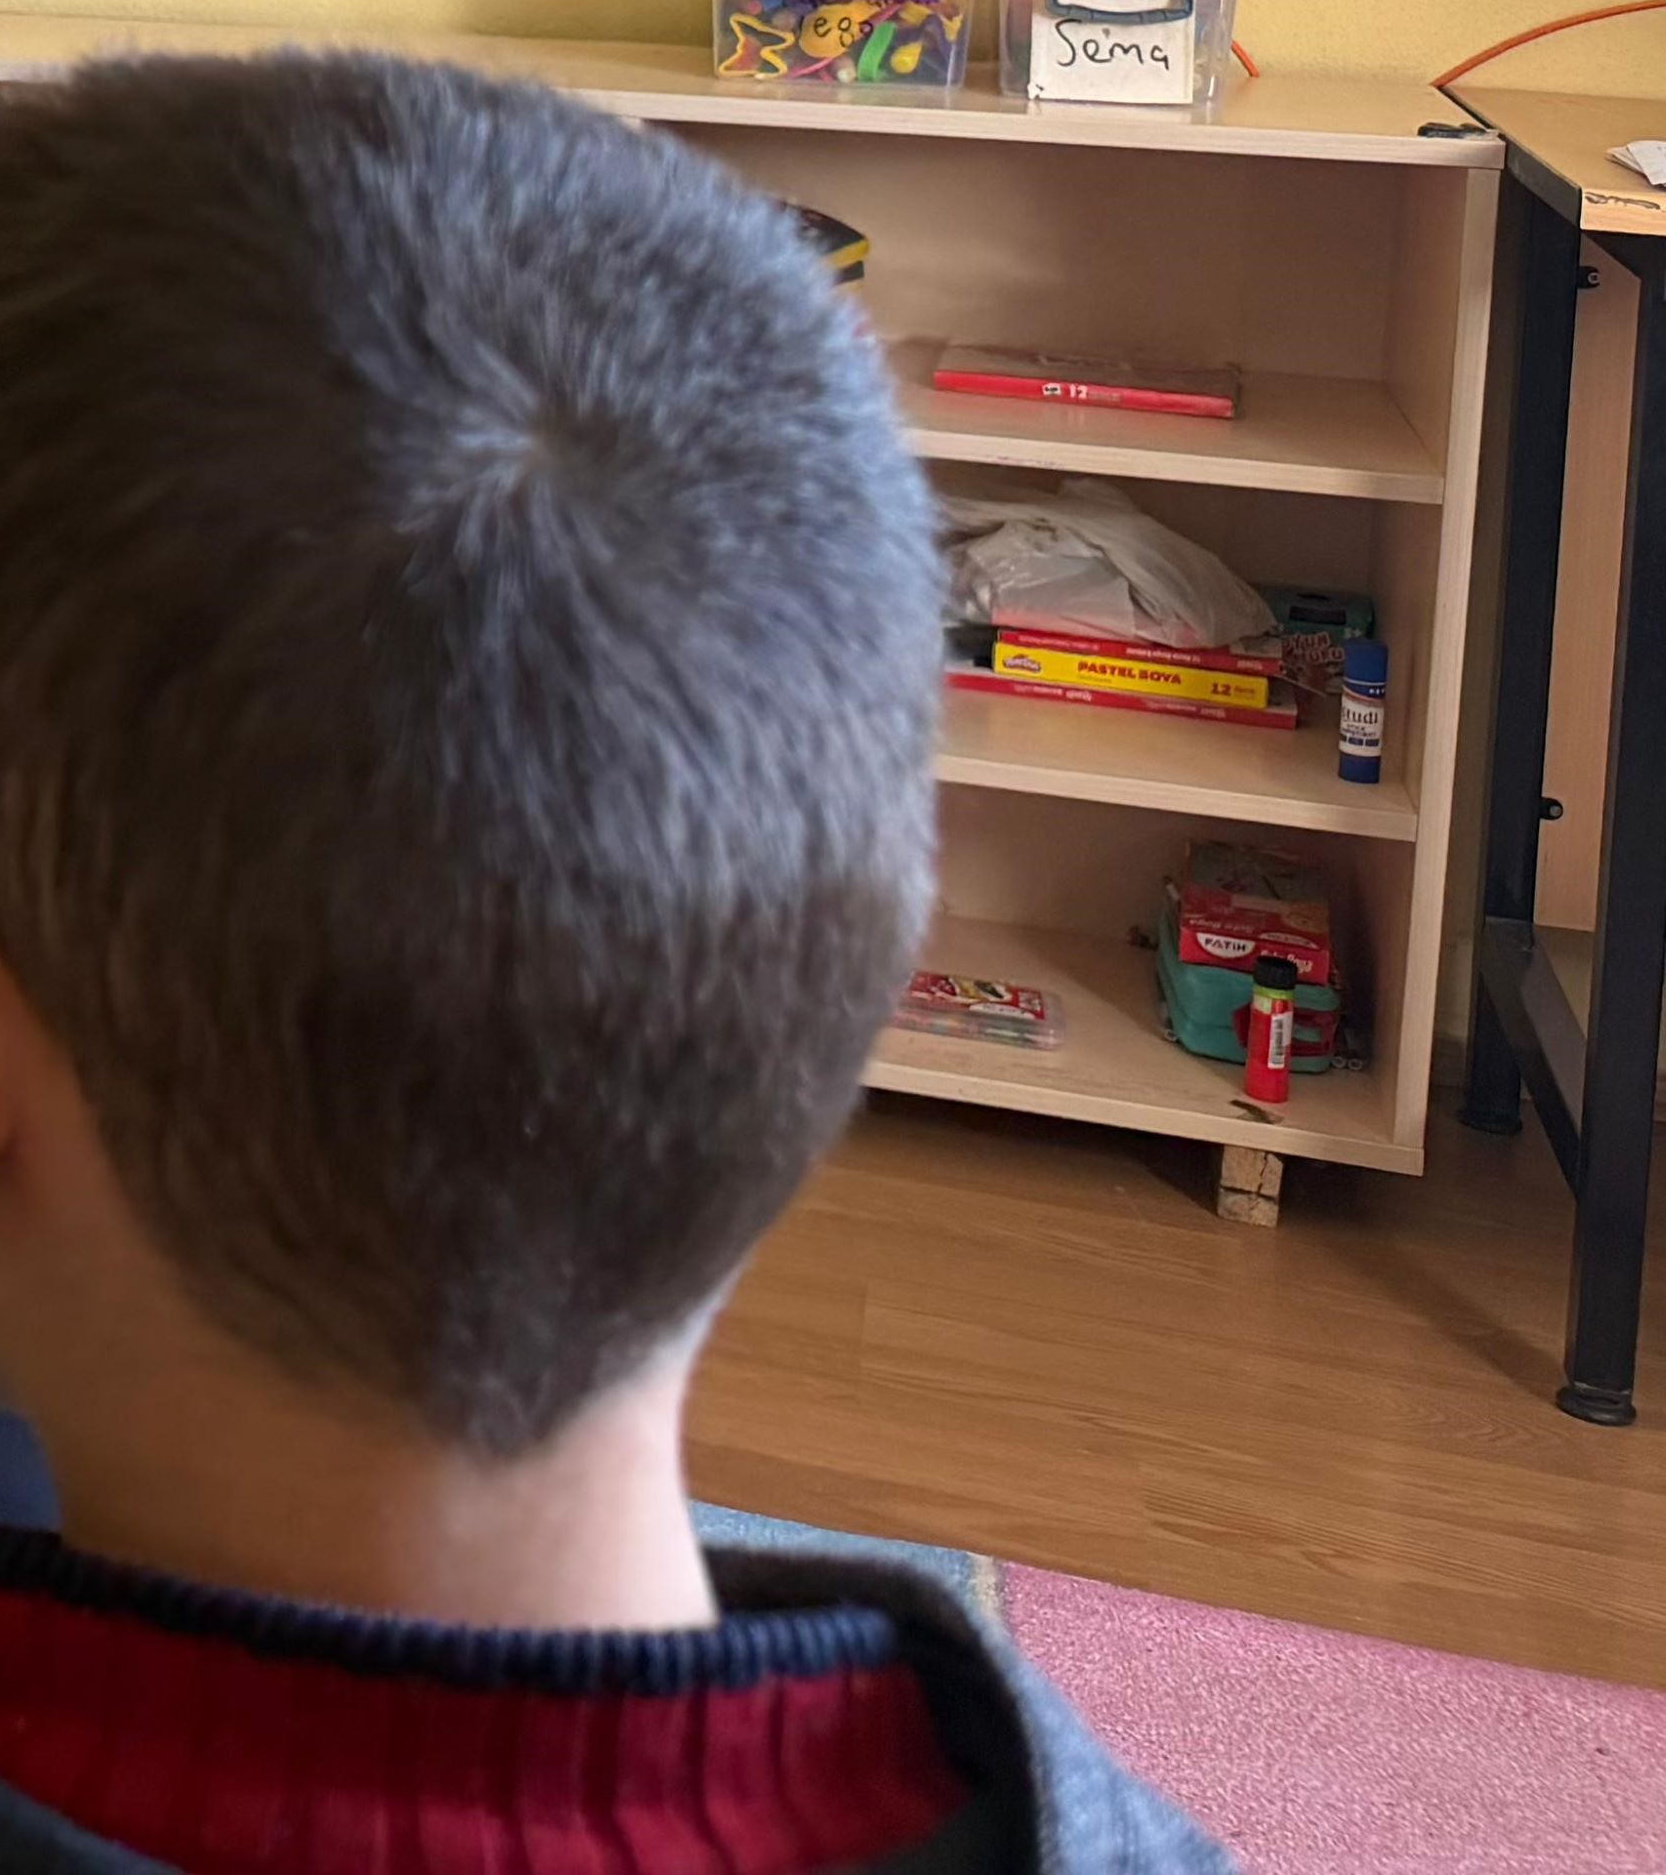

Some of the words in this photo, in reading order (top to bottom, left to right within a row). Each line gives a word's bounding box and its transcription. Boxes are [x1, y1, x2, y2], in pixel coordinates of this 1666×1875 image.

[1055, 19, 1170, 71] Sema
[1069, 383, 1088, 399] 12
[1077, 660, 1137, 680] PASTEL
[1138, 669, 1182, 685] BOYA
[1211, 682, 1232, 696] 12
